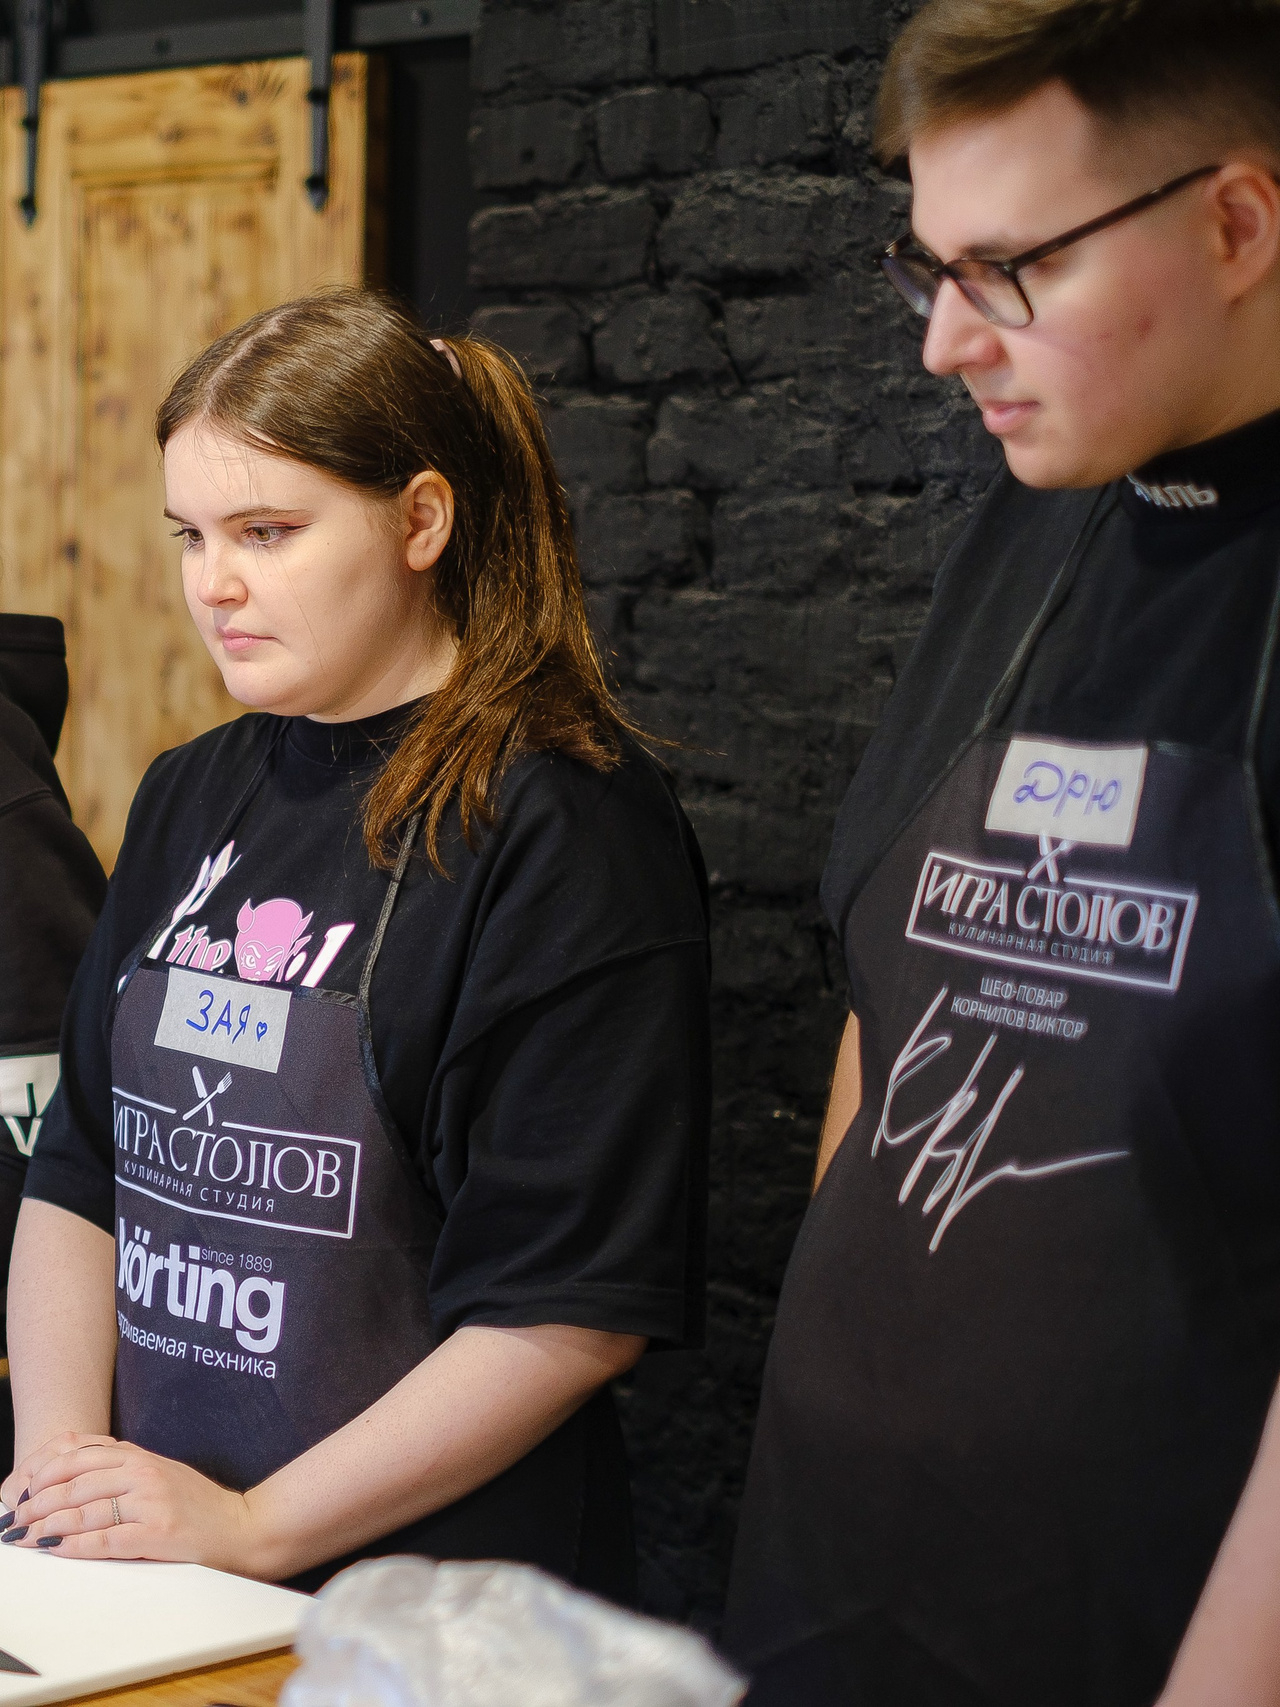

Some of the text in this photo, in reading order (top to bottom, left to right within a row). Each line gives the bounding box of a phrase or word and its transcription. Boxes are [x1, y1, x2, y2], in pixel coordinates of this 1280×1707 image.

[923, 865, 1176, 950] ИГРА СТОЛОВ
[948, 921, 1114, 965] КУЛИНАРНАЯ СТУДИЯ
[980, 976, 1066, 1009] ШЕФ-ПОВАР
[186, 989, 251, 1044] ЗАЯ
[950, 996, 1086, 1039] КОРНИЛОВ ВИКТОР
[113, 1100, 166, 1166] ИГРА
[169, 1127, 341, 1198] СТОЛОВ
[124, 1160, 275, 1213] КУЛИНАРНАЯ СТУДИЯ
[201, 1246, 273, 1273] since 1889
[192, 1345, 277, 1379] техника
